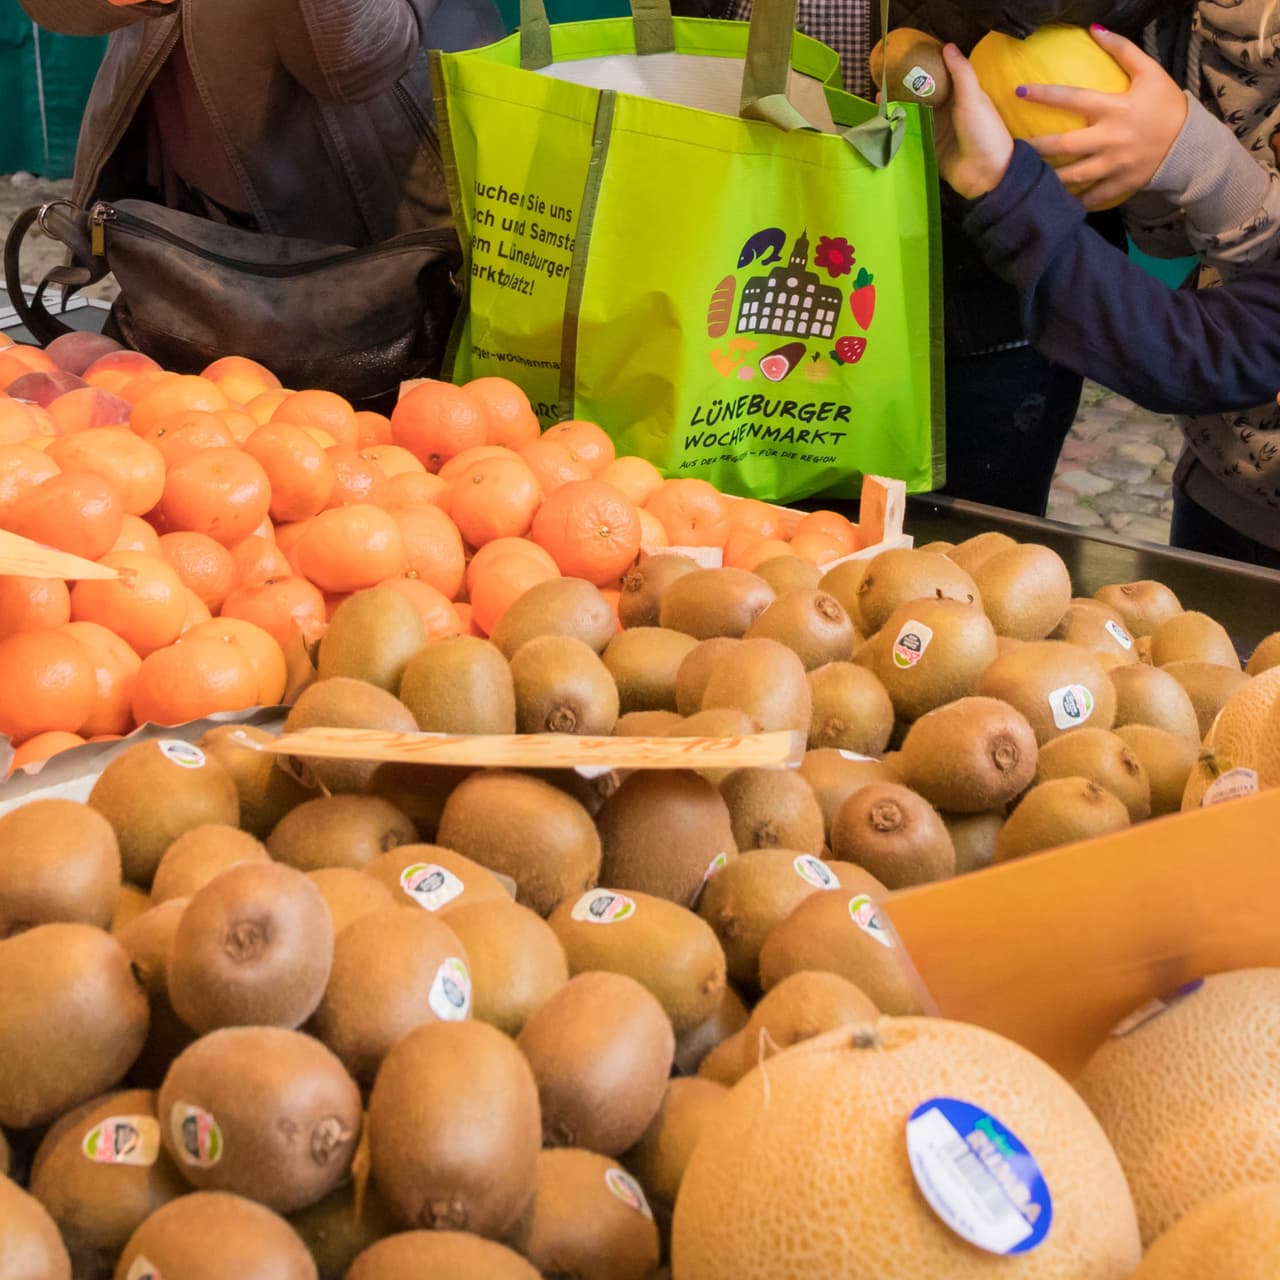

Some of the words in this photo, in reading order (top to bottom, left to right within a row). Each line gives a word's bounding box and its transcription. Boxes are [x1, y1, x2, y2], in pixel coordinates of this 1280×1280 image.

[527, 194, 546, 215] Sie
[550, 203, 573, 223] uns
[497, 240, 570, 280] Lüneburger
[690, 393, 853, 427] LÜNEBURGER
[684, 422, 848, 451] WOCHENMARKT
[679, 459, 697, 470] AUS
[758, 448, 779, 458] FÜR
[780, 451, 798, 460] DIE
[799, 454, 837, 464] REGION
